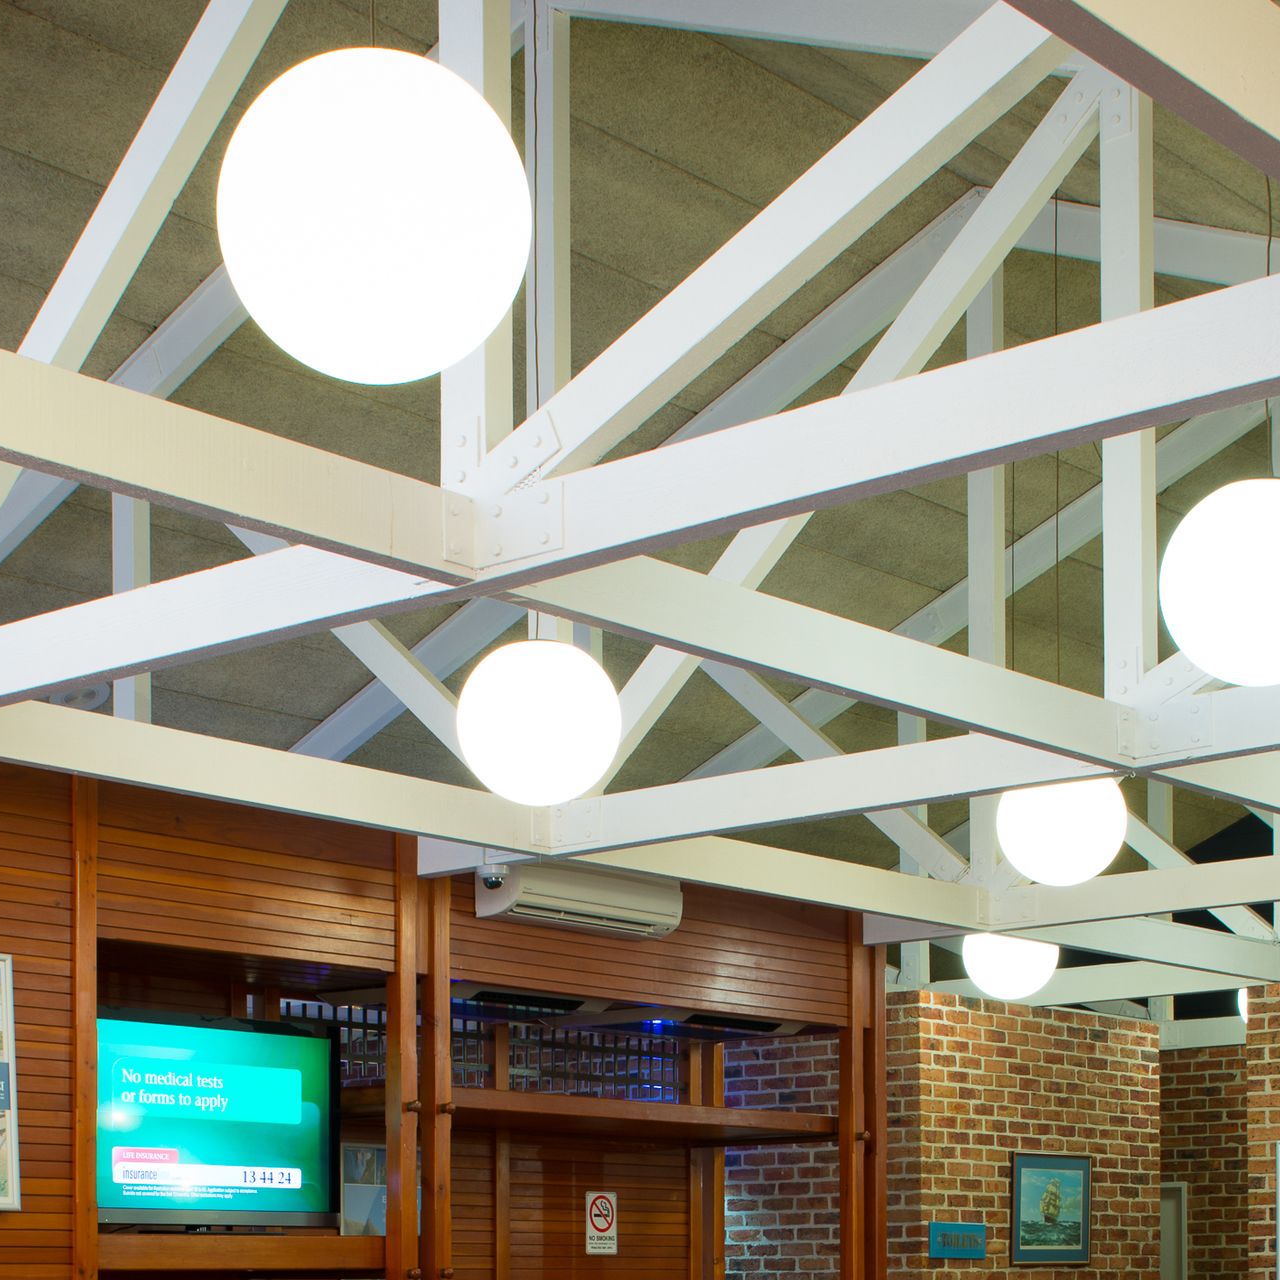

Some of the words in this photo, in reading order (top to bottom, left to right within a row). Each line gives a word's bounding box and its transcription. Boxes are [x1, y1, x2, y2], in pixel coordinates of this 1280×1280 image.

[121, 1068, 141, 1083] No
[145, 1071, 193, 1087] medical
[196, 1075, 224, 1089] tests
[121, 1091, 136, 1103] or
[139, 1089, 175, 1105] forms
[178, 1093, 192, 1106] to
[194, 1094, 229, 1112] apply
[122, 1151, 135, 1159] LIFE
[135, 1152, 169, 1160] INSURANCE
[243, 1170, 256, 1184] 13
[259, 1171, 274, 1184] 44
[278, 1171, 292, 1185] 24
